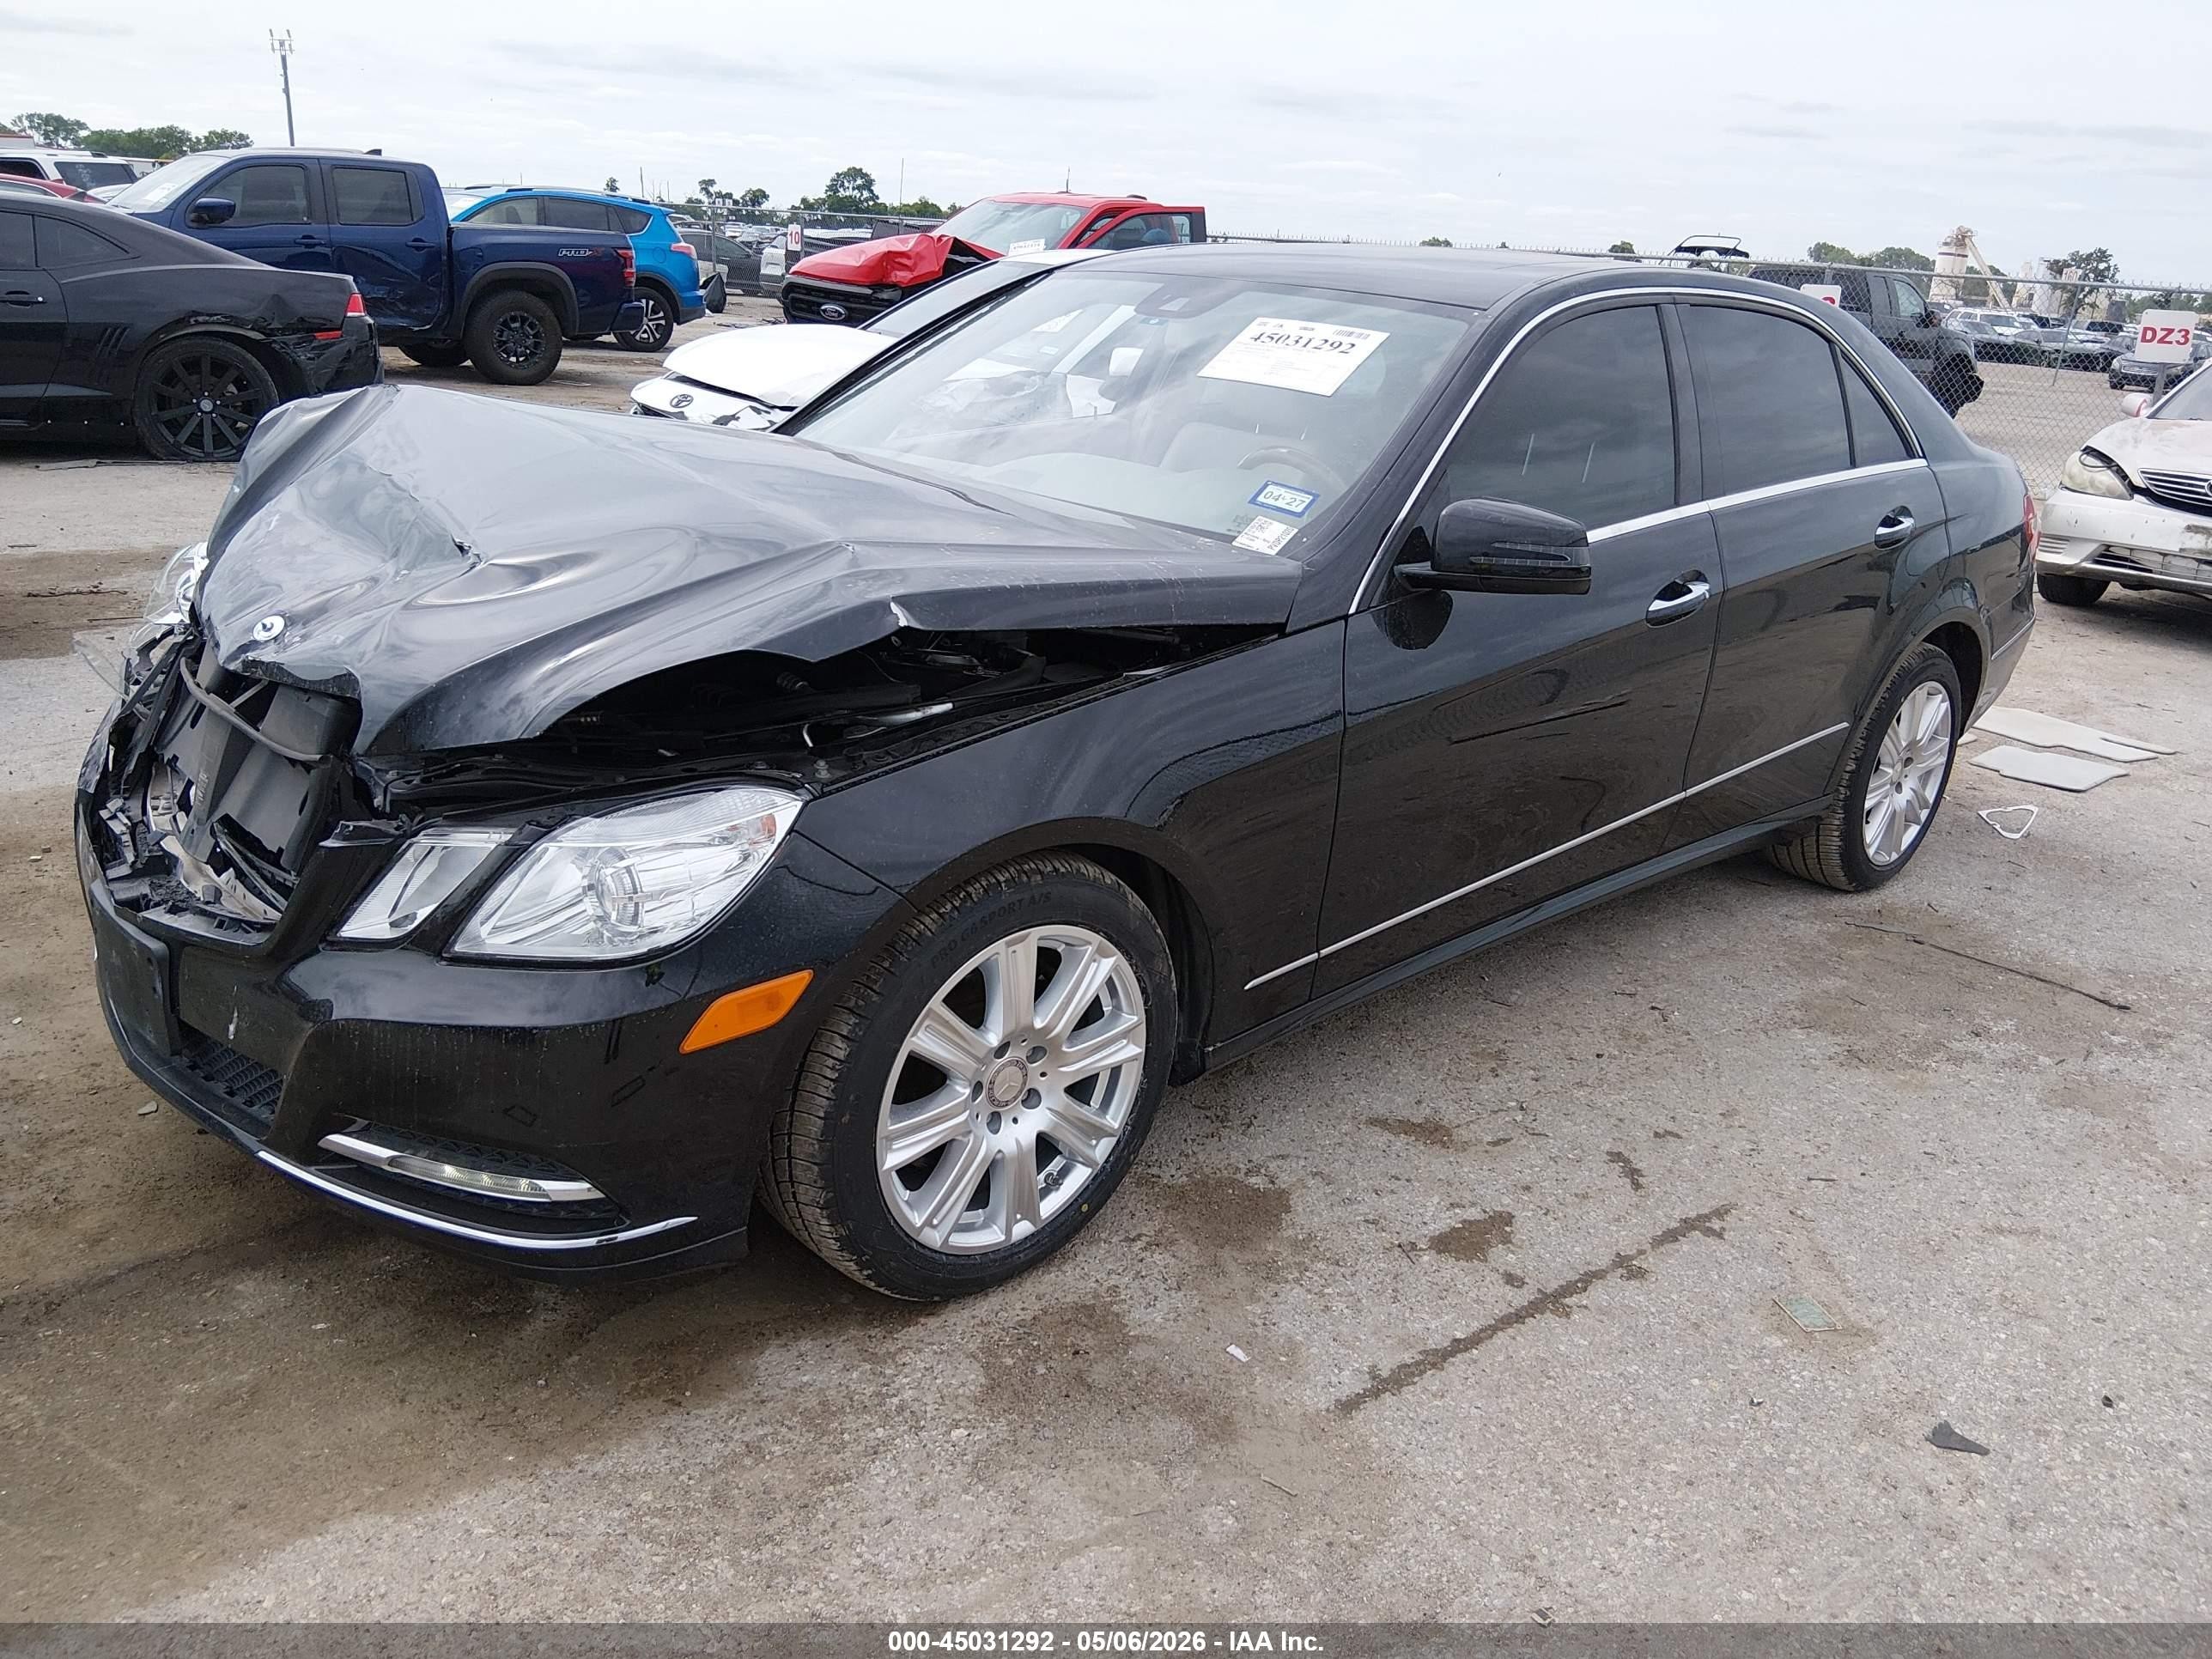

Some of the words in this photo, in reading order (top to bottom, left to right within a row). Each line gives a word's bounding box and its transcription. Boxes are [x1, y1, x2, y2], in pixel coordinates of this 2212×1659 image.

[788, 231, 799, 245] 10
[1249, 331, 1356, 355] 45031292
[2141, 326, 2191, 346] DZ3
[980, 898, 1025, 927] SPORT
